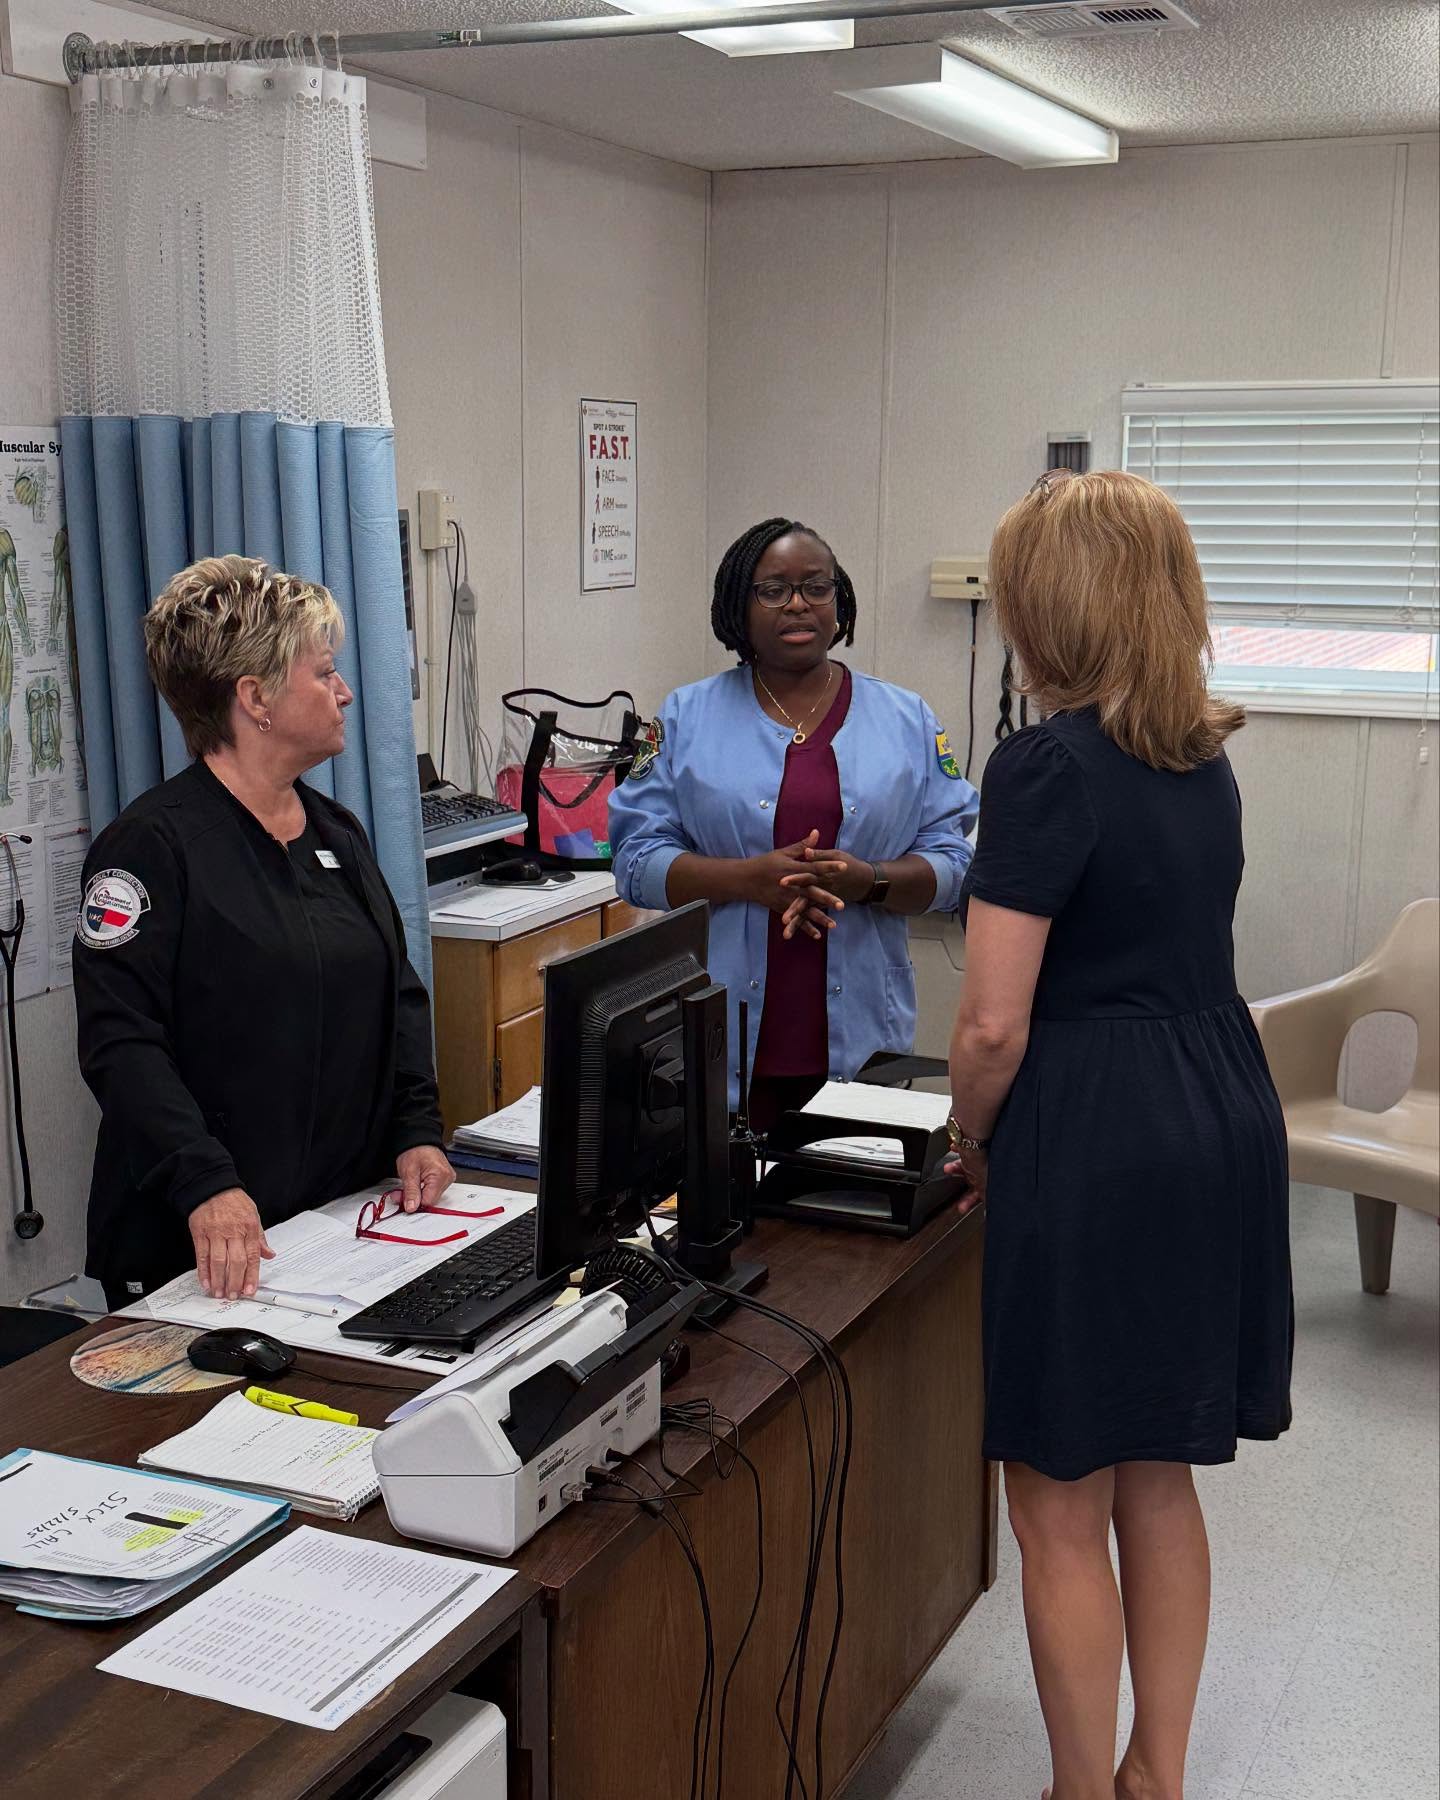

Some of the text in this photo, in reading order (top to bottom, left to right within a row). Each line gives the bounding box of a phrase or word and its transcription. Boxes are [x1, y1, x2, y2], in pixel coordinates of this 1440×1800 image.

[593, 423, 604, 431] SPOT
[608, 424, 625, 432] STROKE
[602, 469, 615, 482] FACE
[602, 497, 615, 510] ARM
[598, 525, 619, 537] SPEECH
[600, 549, 613, 561] TIME
[112, 870, 146, 899] CORRECTION
[22, 1491, 128, 1549] SICK CALL
[26, 1506, 79, 1539] 5/22/25
